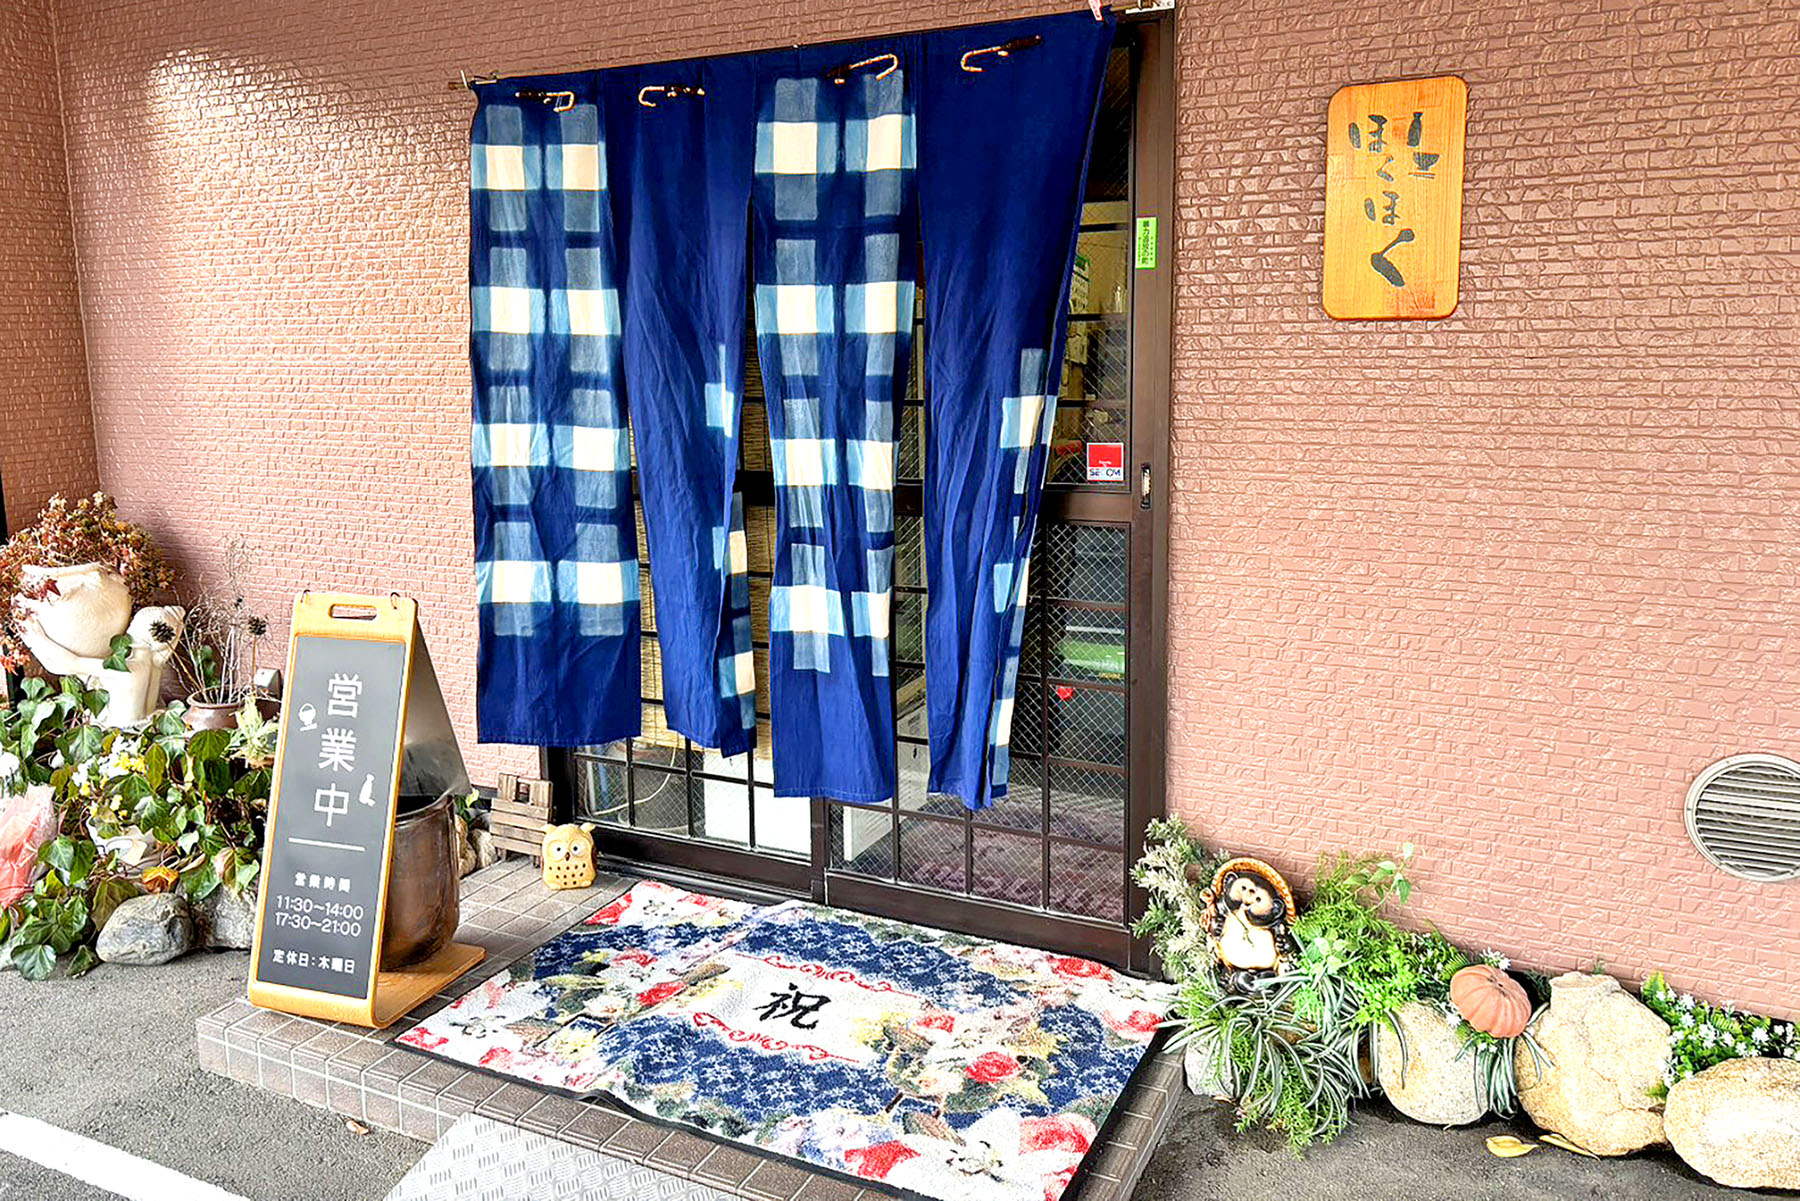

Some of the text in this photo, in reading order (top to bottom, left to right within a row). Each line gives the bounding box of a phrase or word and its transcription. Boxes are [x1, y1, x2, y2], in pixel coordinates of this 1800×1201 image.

[1348, 112, 1415, 287] ほくほく
[313, 672, 363, 827] 営業中
[294, 872, 351, 893] 営業時間
[272, 949, 355, 974] 定休日：木曜日
[753, 982, 832, 1030] 祝
